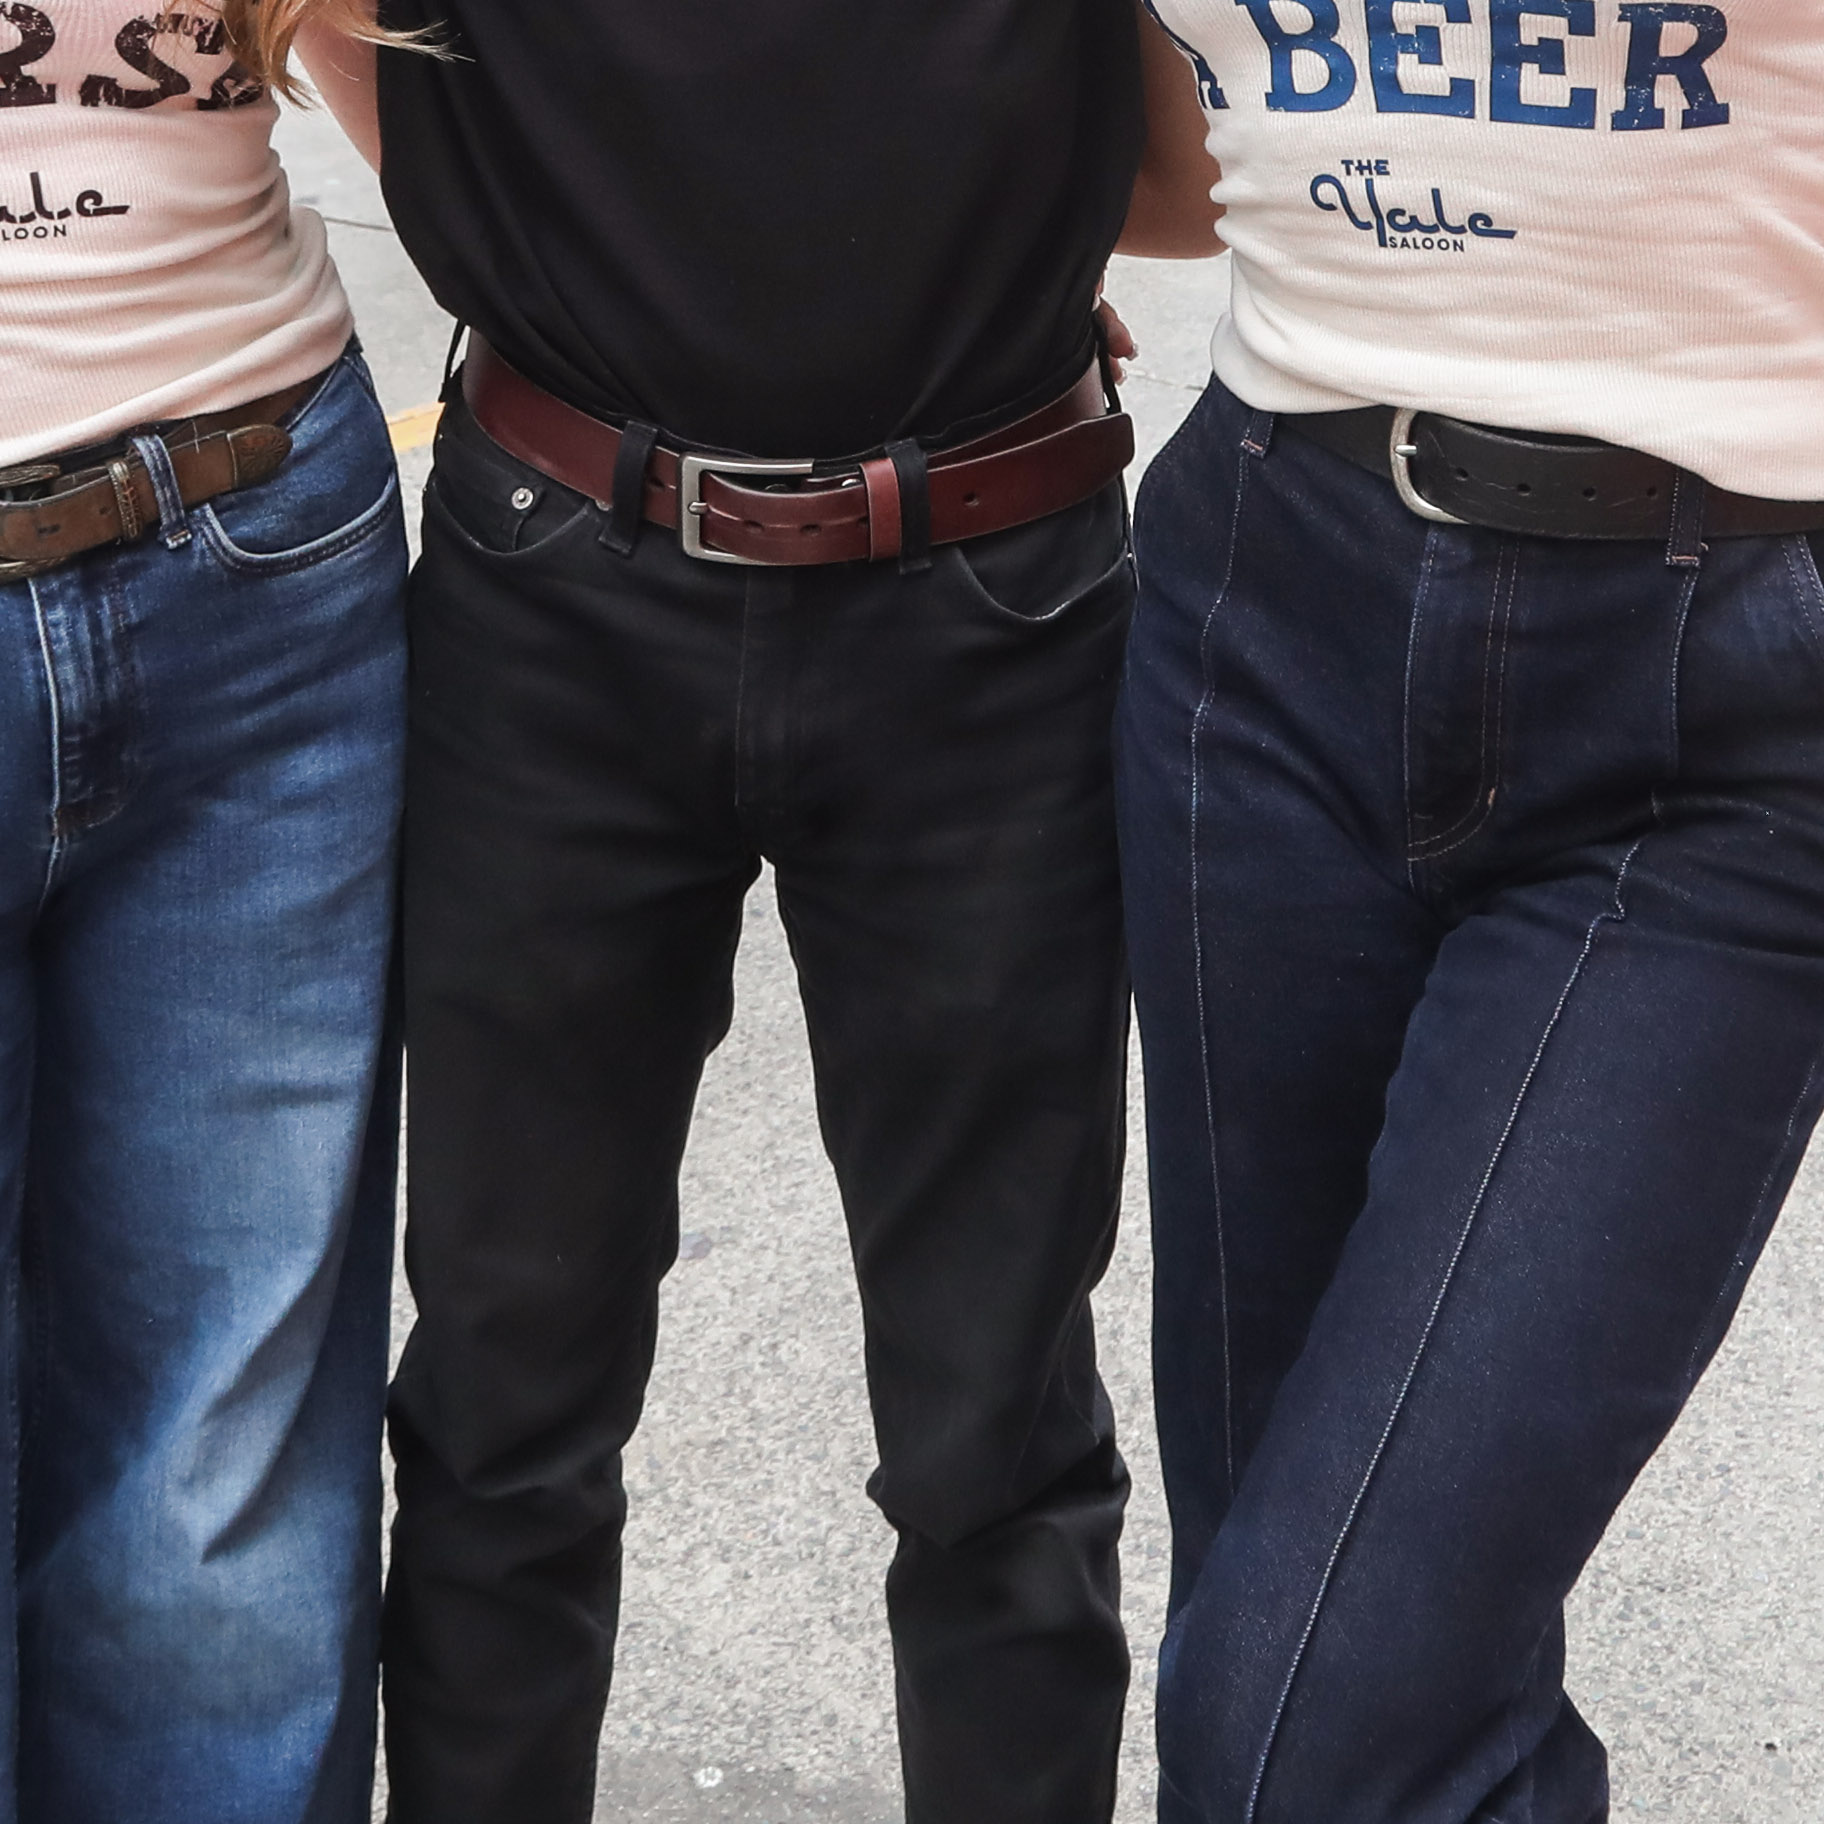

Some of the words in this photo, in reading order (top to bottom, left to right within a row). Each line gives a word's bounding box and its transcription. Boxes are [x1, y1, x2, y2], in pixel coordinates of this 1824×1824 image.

[1341, 158, 1390, 177] THE
[1309, 173, 1518, 248] Yale
[1387, 234, 1466, 253] SALOON
